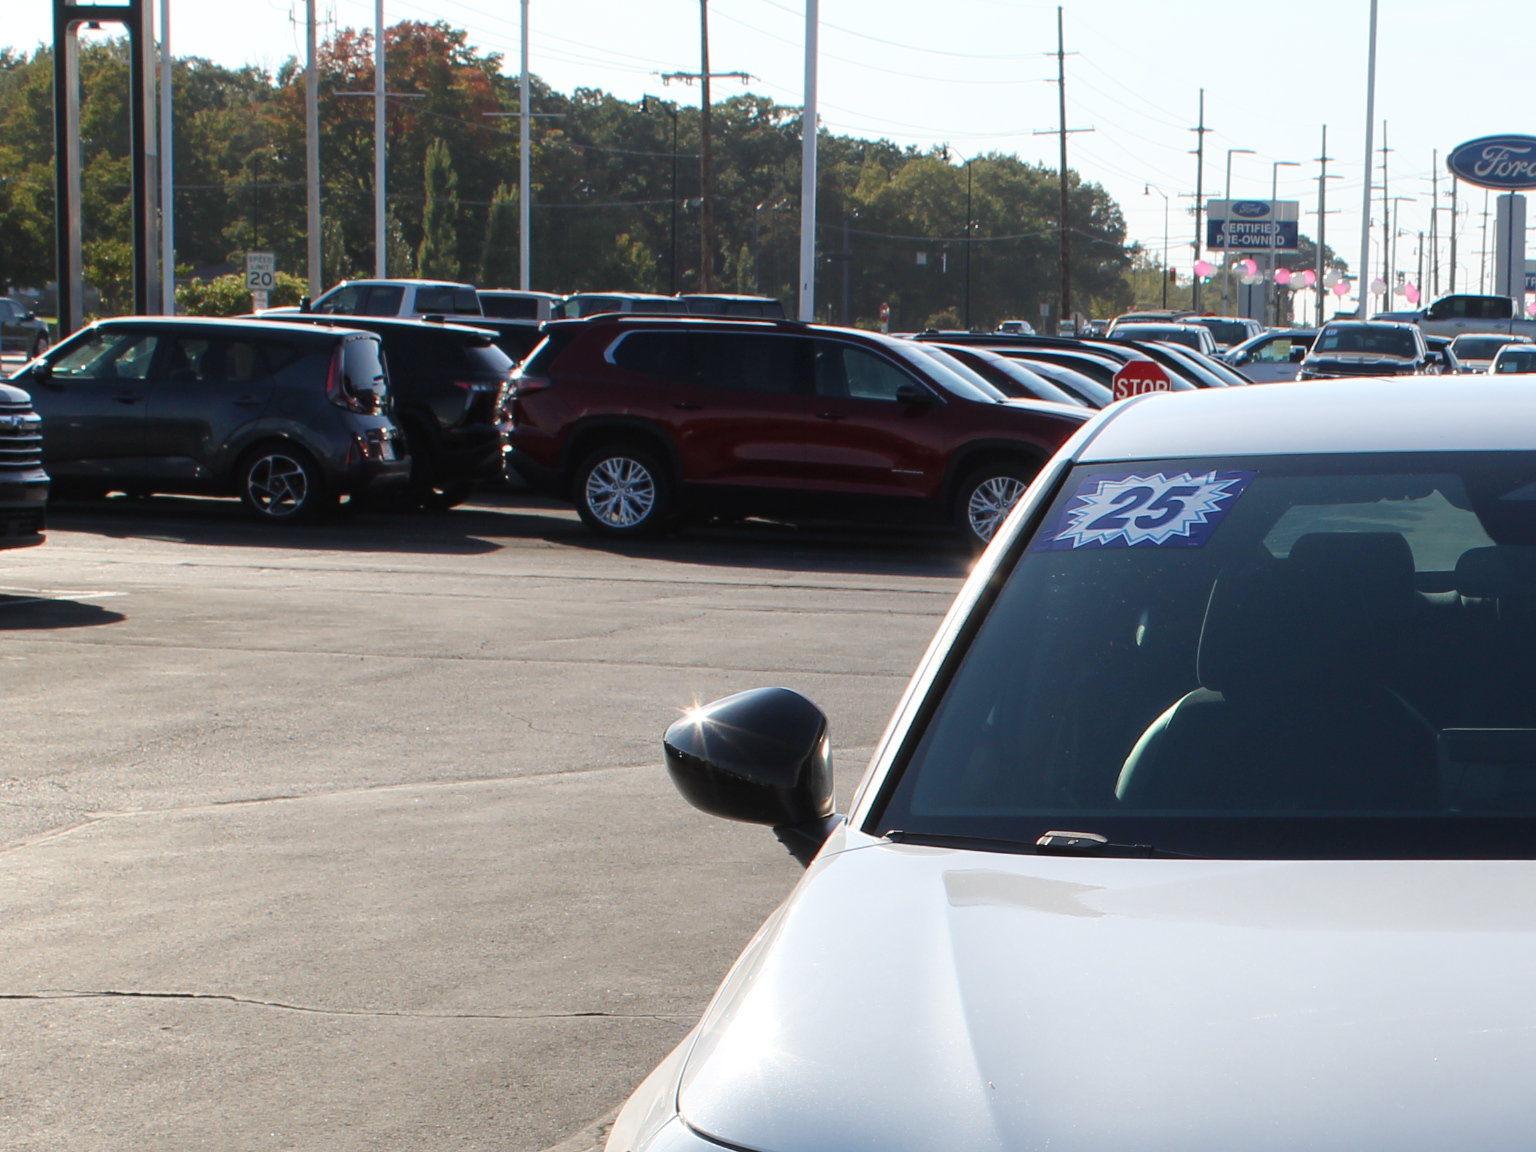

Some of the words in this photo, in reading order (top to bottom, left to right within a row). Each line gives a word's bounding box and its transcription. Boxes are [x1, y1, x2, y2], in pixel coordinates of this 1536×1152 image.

[1216, 234, 1285, 246] PE-OWND
[250, 271, 273, 286] 20
[1085, 485, 1200, 530] 25
